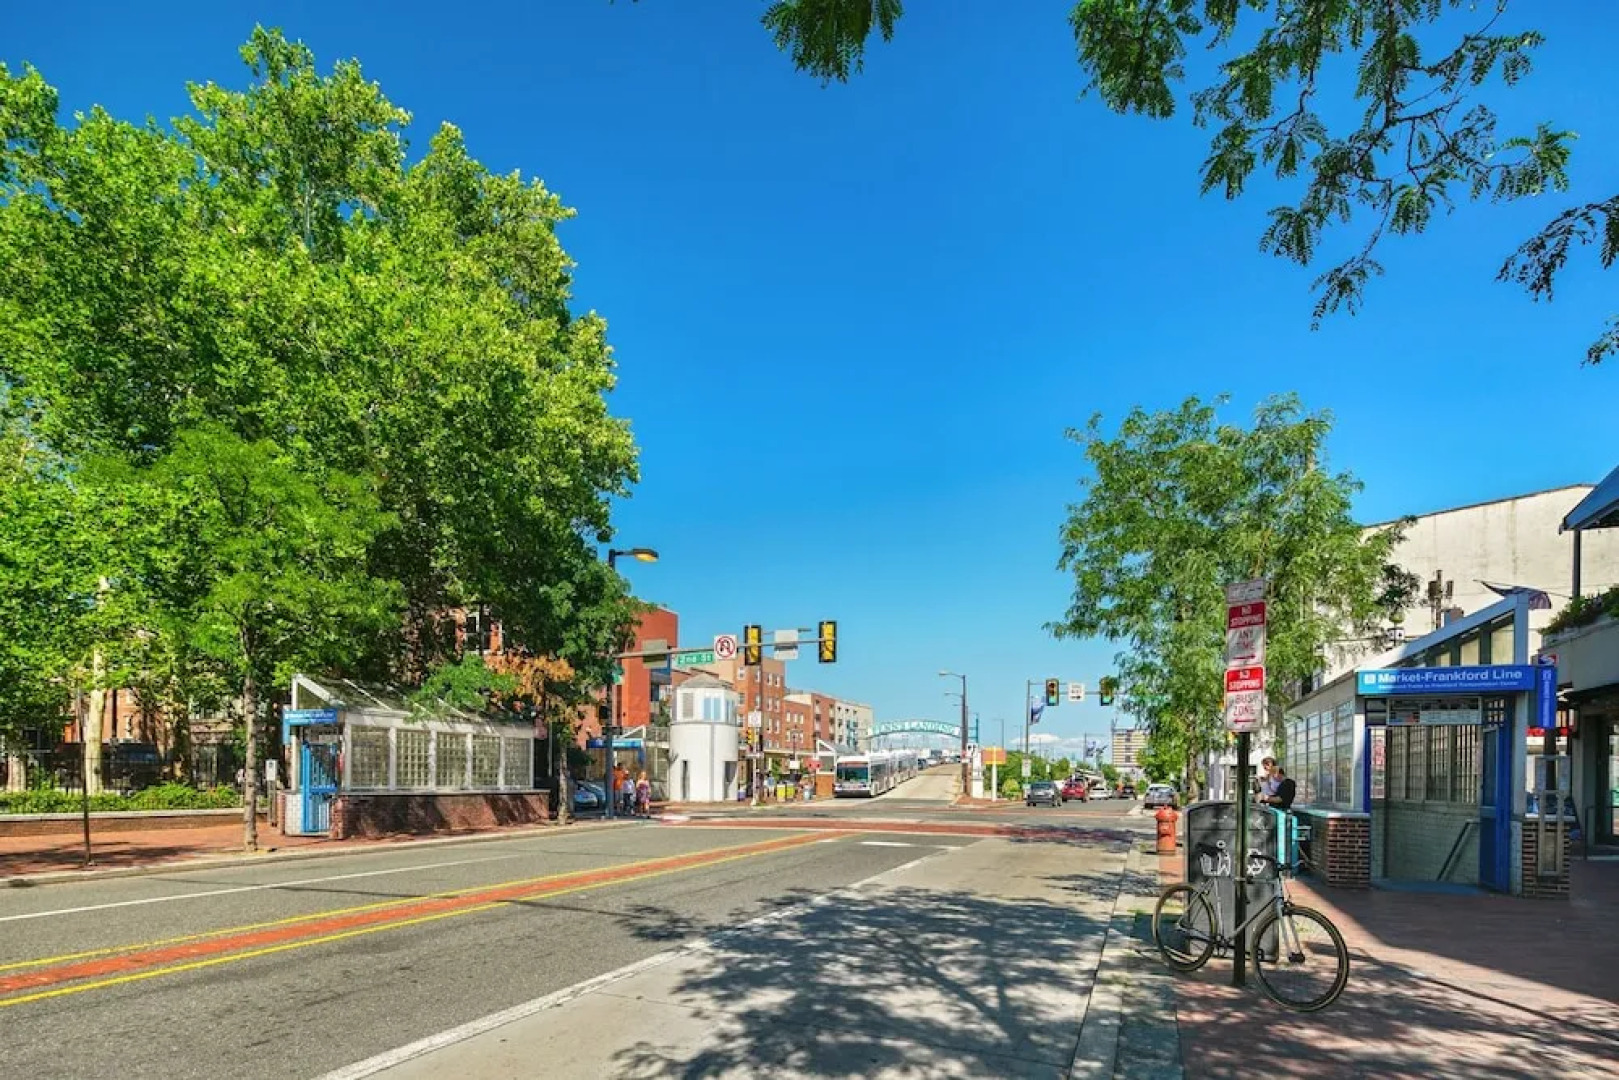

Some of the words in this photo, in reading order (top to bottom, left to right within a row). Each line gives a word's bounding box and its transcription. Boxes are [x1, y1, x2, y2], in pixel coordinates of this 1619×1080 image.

[1241, 605, 1252, 616] NO
[1379, 670, 1488, 683] Market-Frankford
[1492, 669, 1522, 680] Line
[1229, 679, 1260, 690] STOPPING
